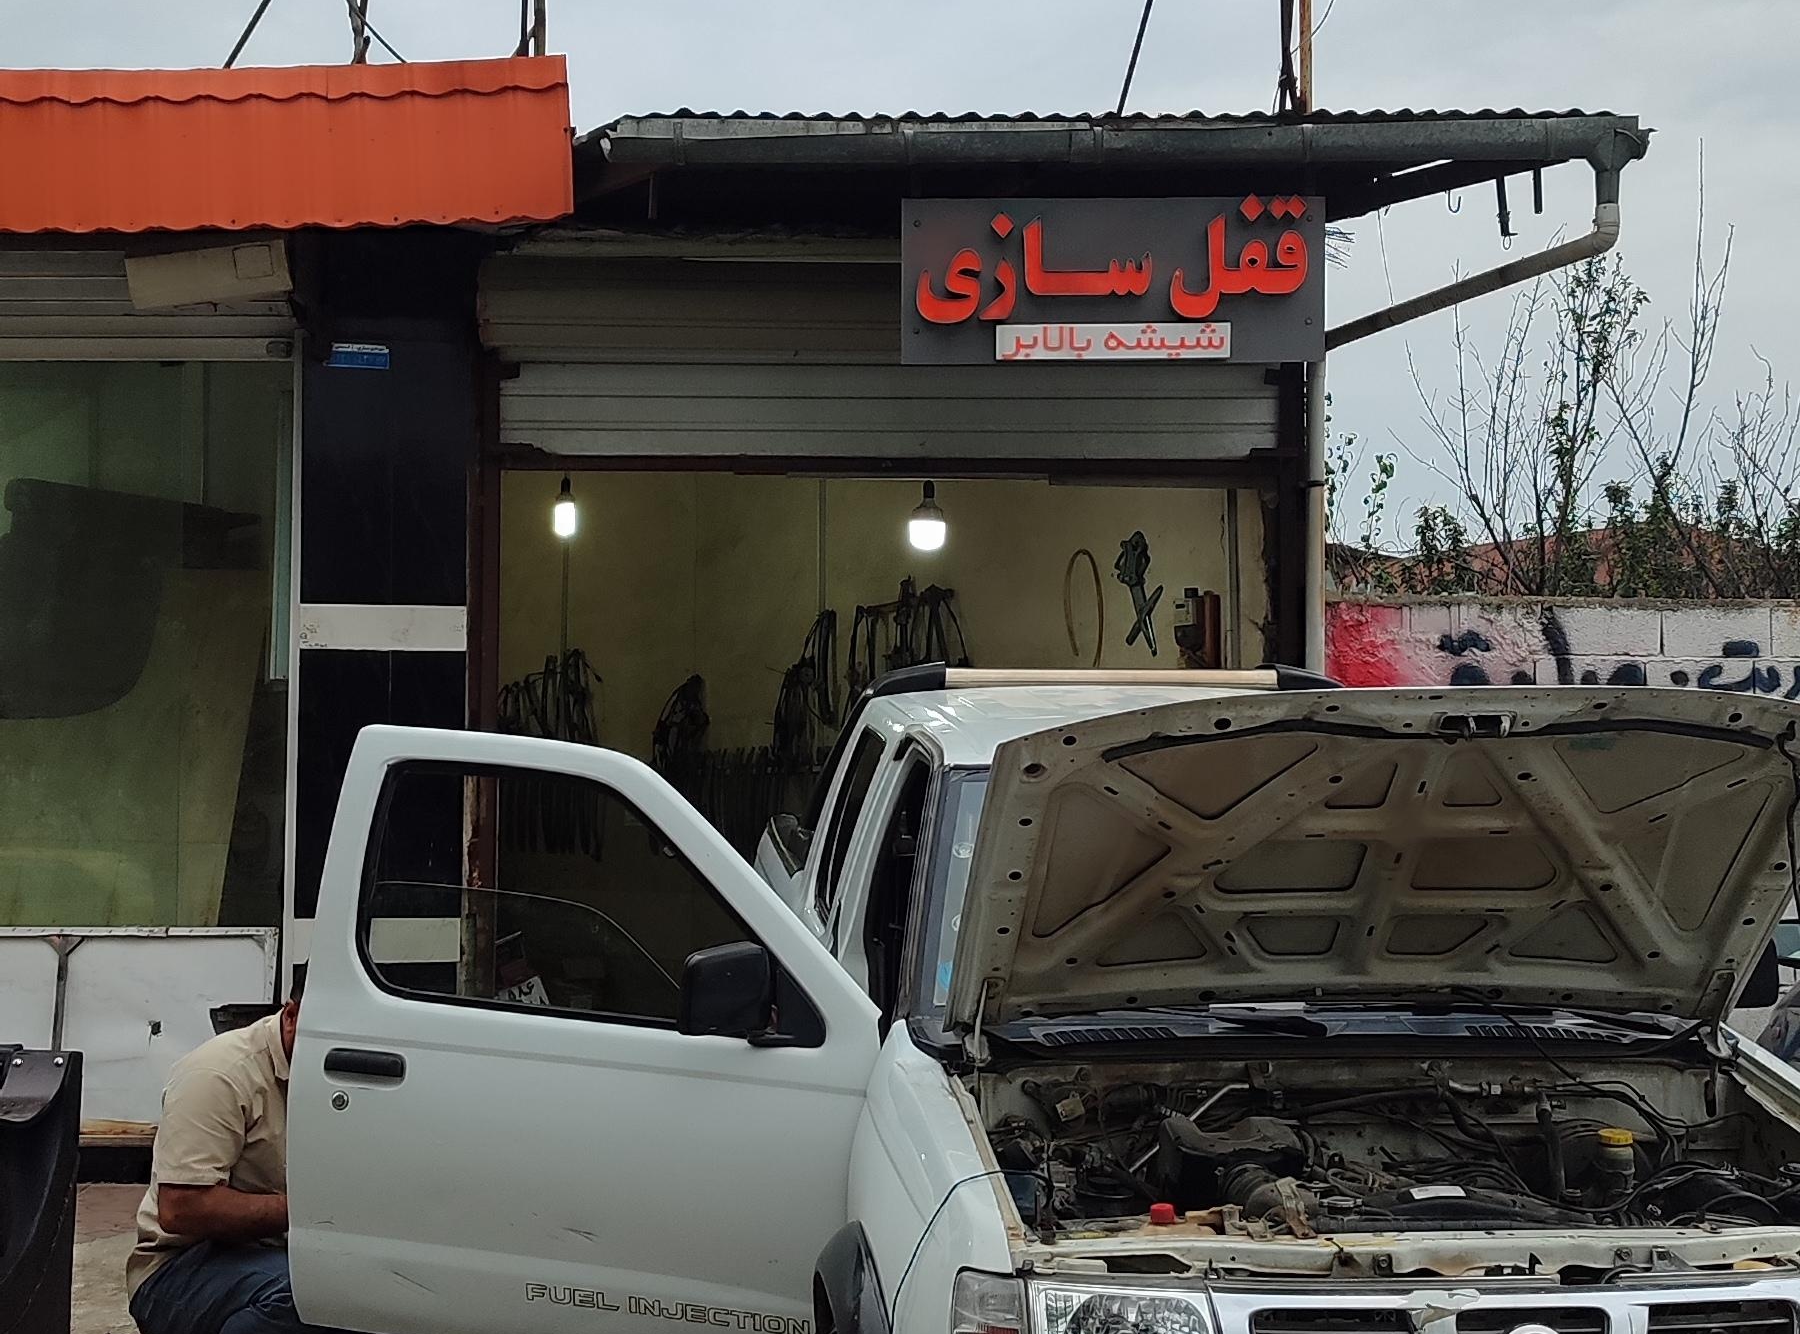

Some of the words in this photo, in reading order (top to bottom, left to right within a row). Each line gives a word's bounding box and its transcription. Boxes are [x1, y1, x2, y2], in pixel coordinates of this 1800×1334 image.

[916, 211, 1153, 324] سازی
[1170, 193, 1308, 319] قفل
[1001, 324, 1093, 359] بالابر
[1103, 323, 1226, 359] شیشه
[525, 1282, 620, 1312] FUEL
